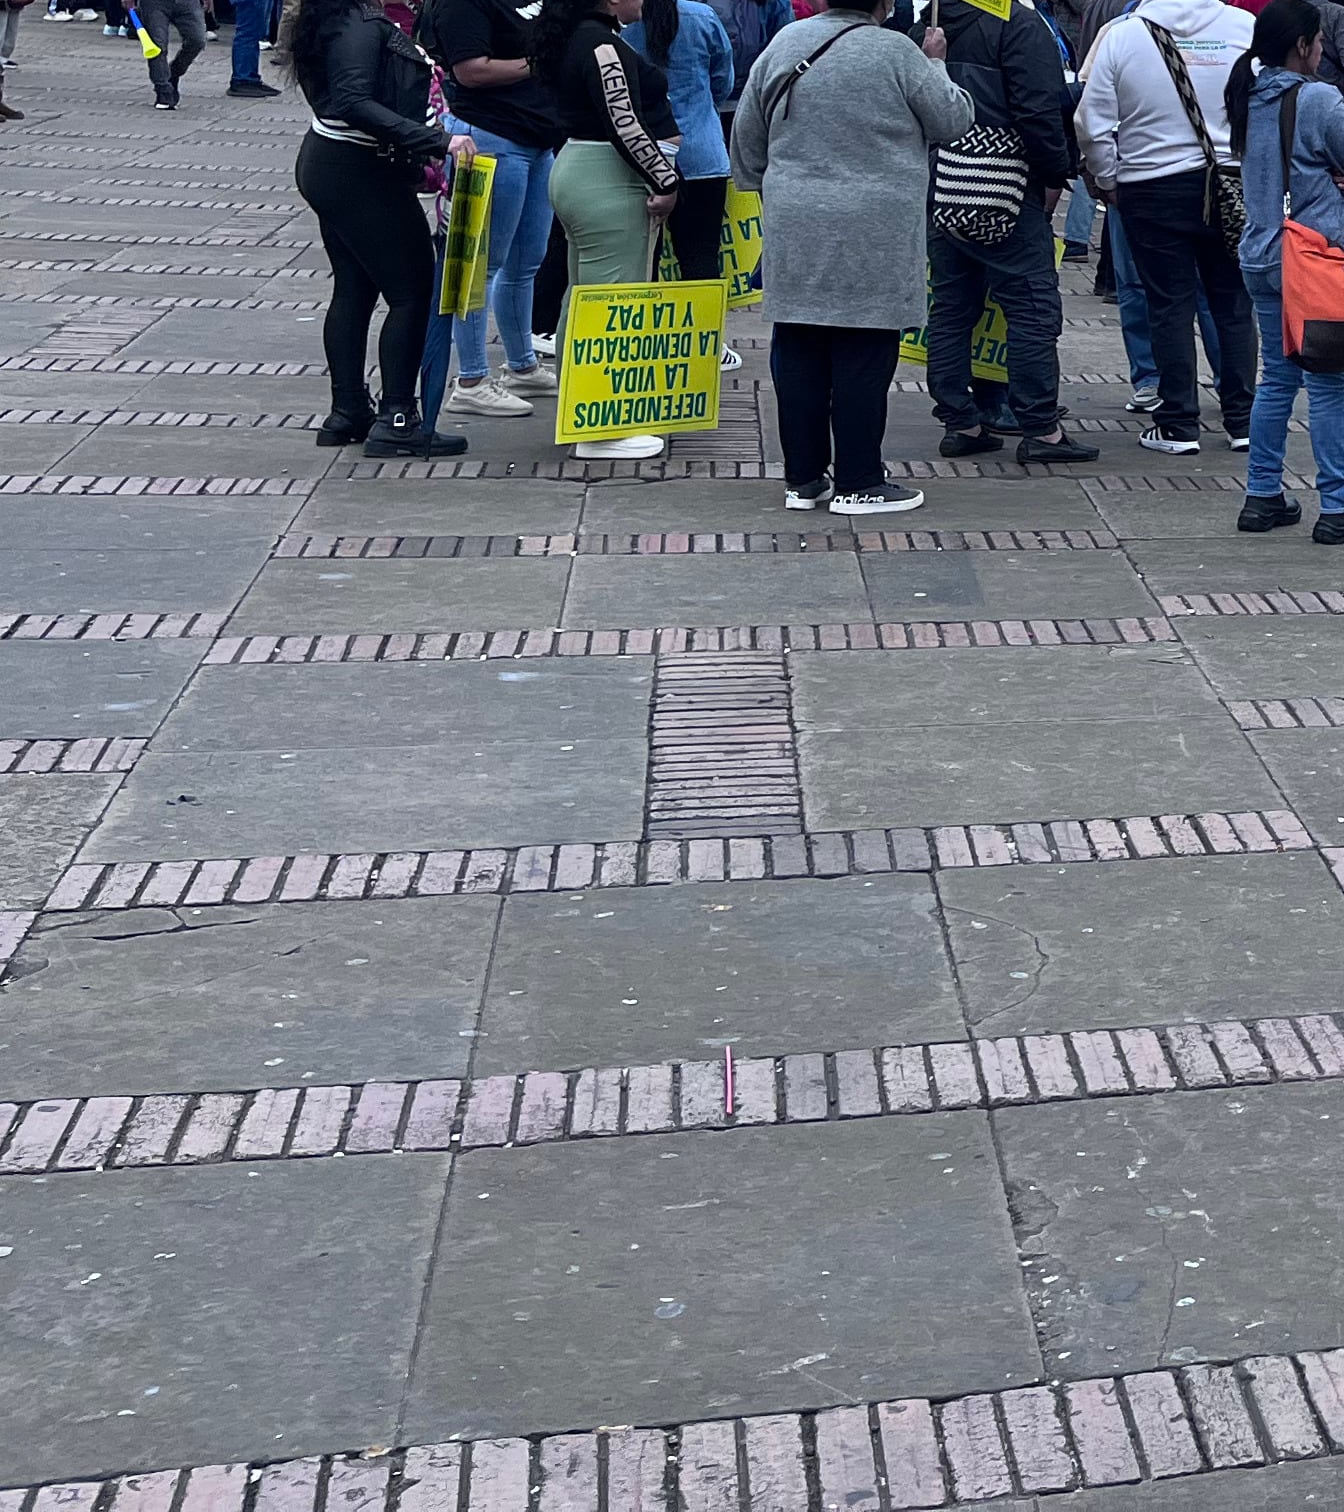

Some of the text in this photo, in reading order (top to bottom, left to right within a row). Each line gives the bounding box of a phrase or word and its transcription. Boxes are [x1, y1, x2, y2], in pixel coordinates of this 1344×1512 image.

[601, 61, 635, 128] KENZO
[624, 133, 677, 189] KENZO
[606, 301, 693, 332] Y LA PAZ
[574, 330, 719, 365] LA DEMOCRACIA
[604, 363, 688, 394] LA VIDA,
[574, 392, 707, 428] DEFENDEMOS
